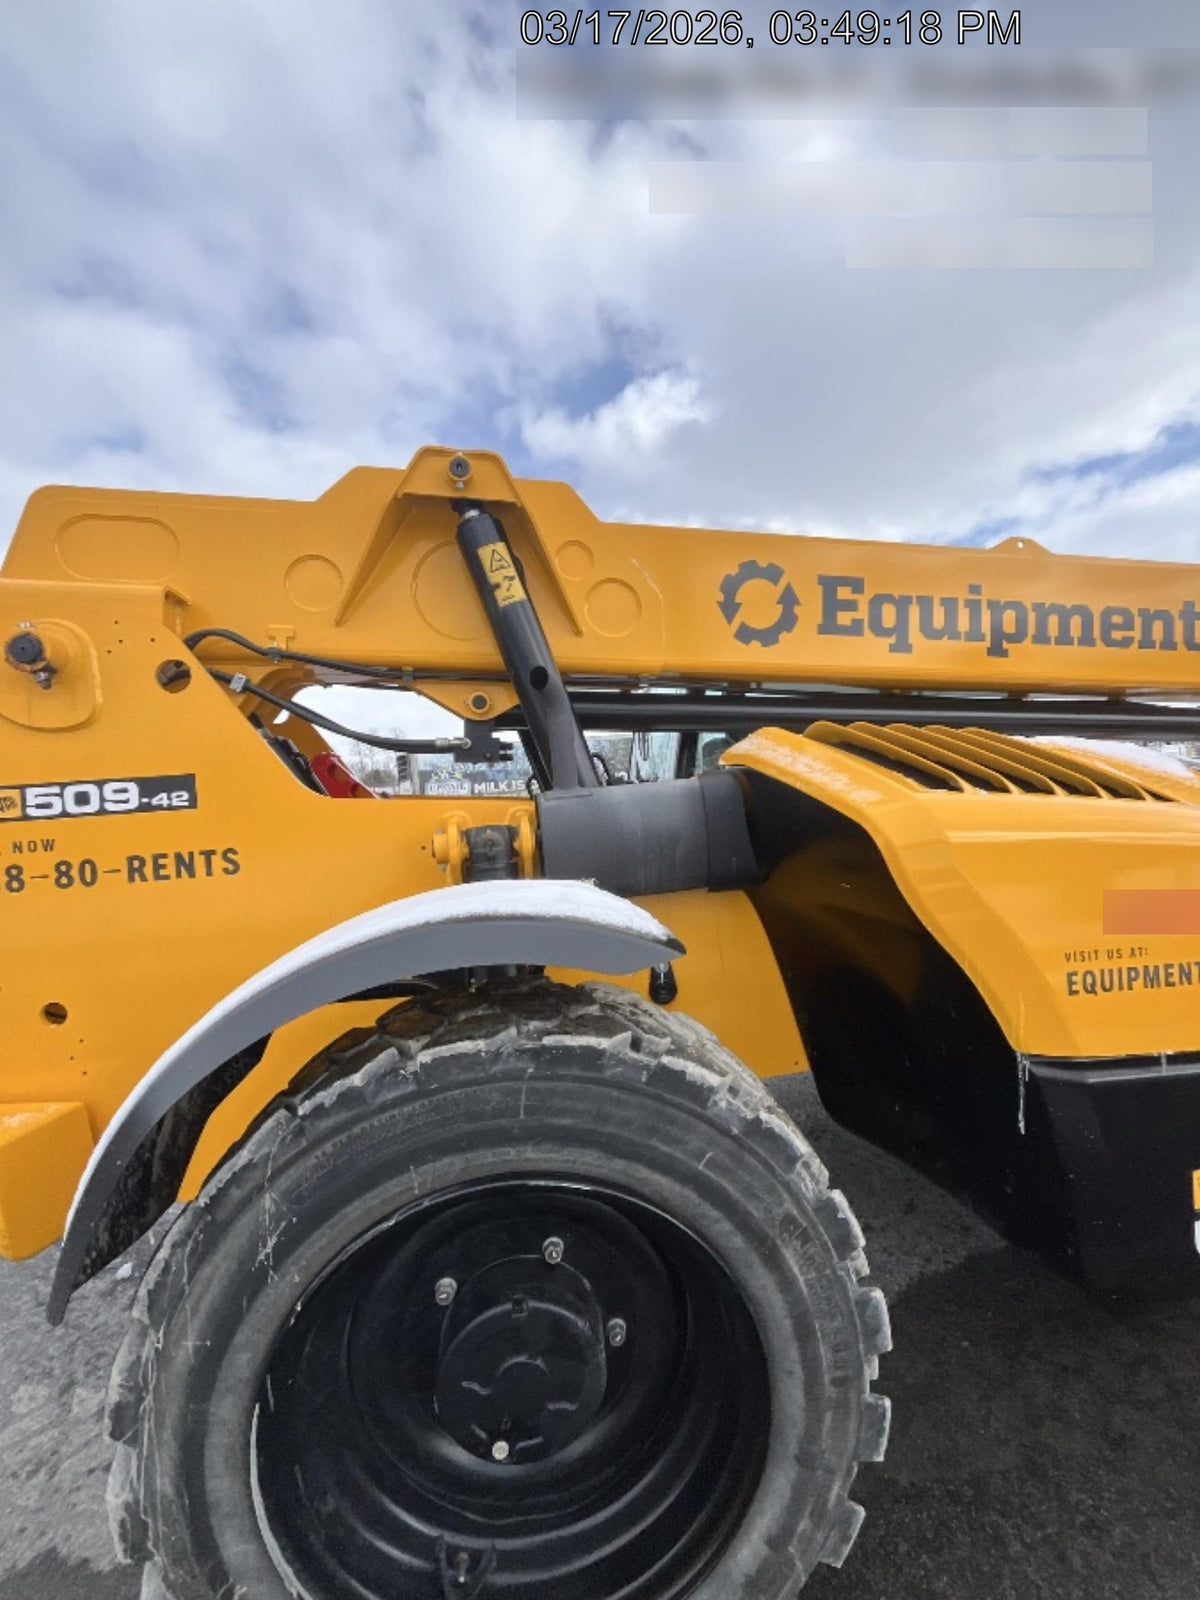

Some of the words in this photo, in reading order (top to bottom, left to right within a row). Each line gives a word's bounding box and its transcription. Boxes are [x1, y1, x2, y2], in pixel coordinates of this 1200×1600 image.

[817, 574, 1200, 658] Equipment
[474, 780, 508, 794] MILK
[25, 781, 190, 817] 509-42
[12, 838, 56, 854] NOW
[1064, 949, 1099, 963] VISIT
[1107, 948, 1123, 960] US
